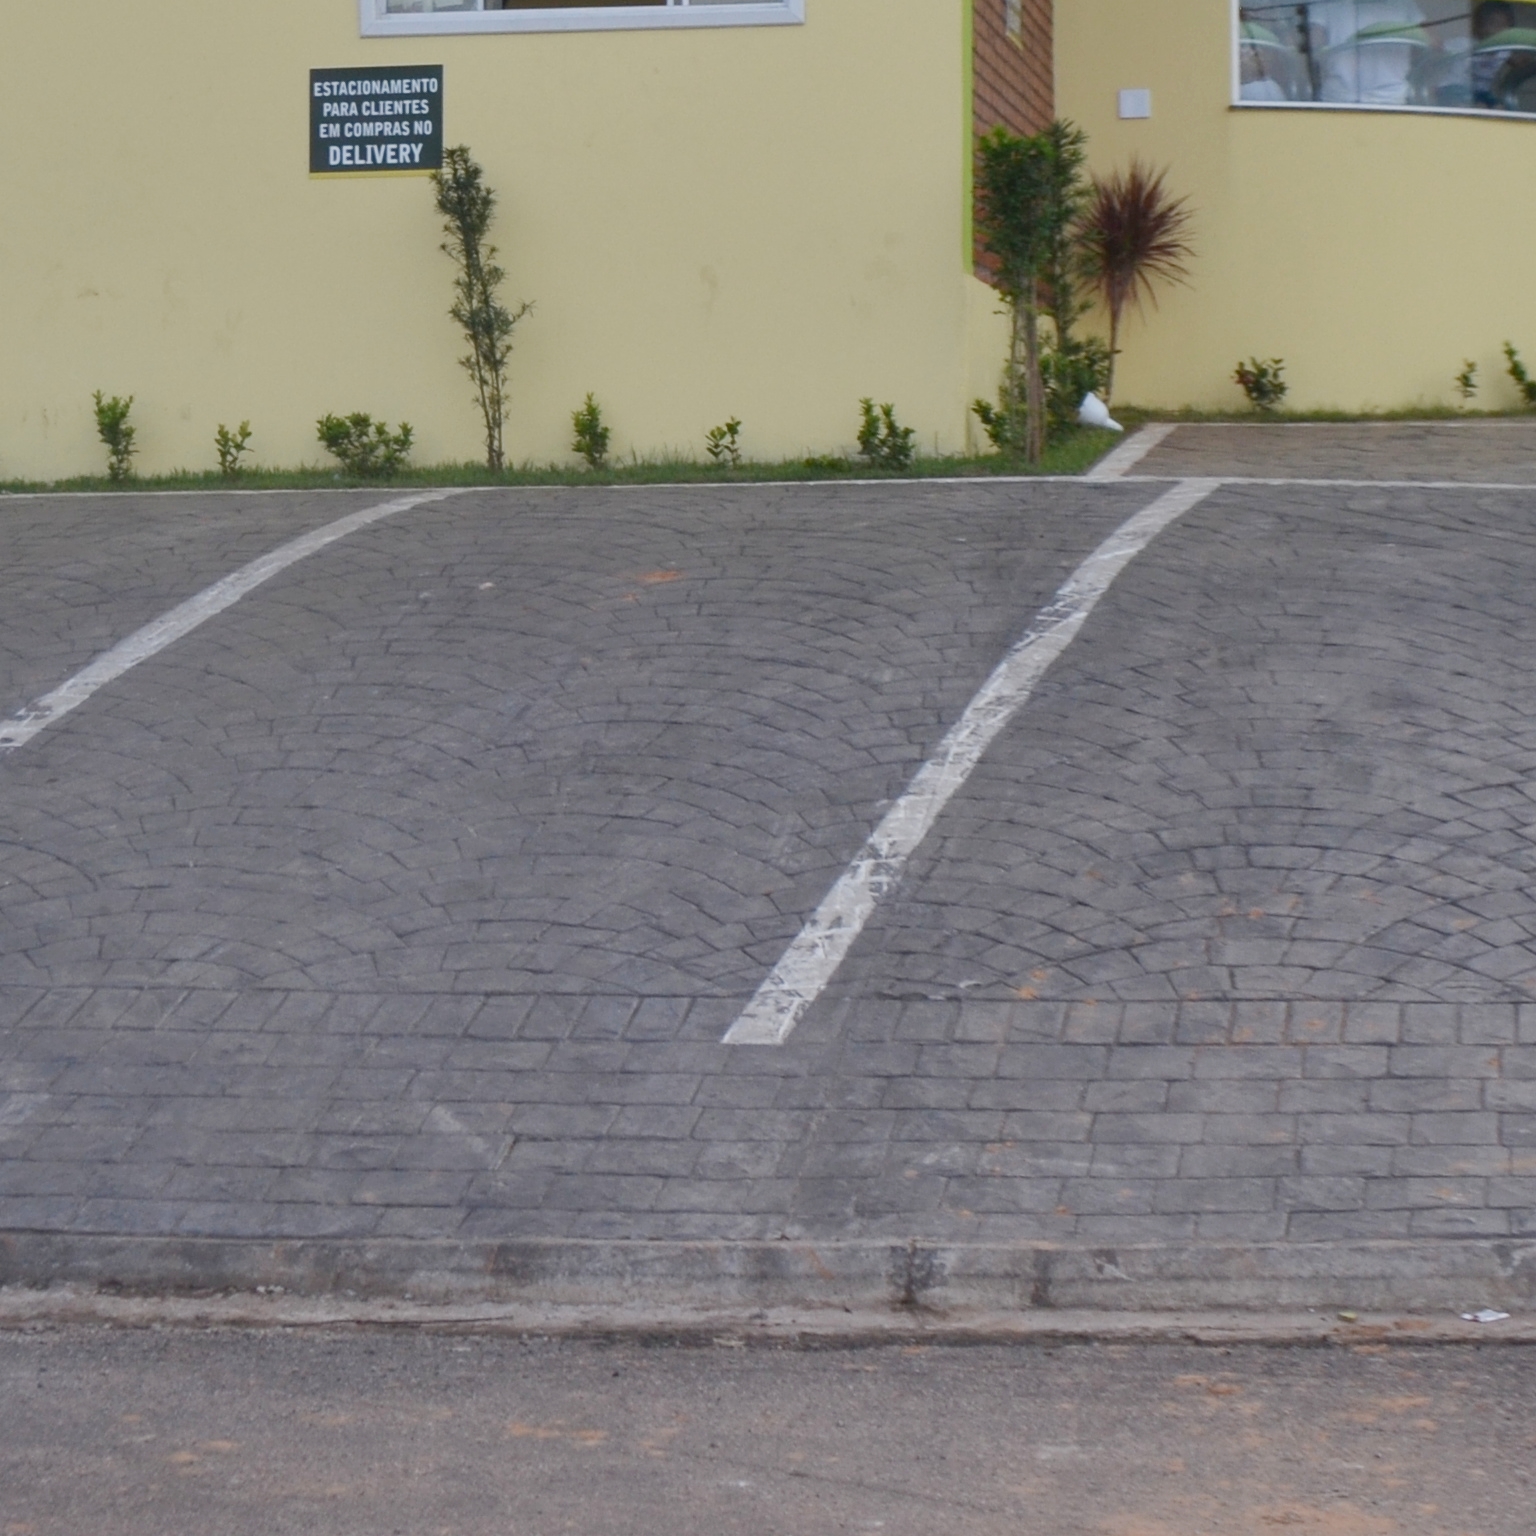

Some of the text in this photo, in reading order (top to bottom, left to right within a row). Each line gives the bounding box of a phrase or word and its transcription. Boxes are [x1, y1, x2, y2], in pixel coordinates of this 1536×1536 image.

[313, 78, 438, 97] ESTACIONAMENTO
[323, 99, 430, 117] PARA CLIENTES
[319, 120, 433, 138] EM COMPRAS NO
[329, 143, 423, 166] DELIVERY
